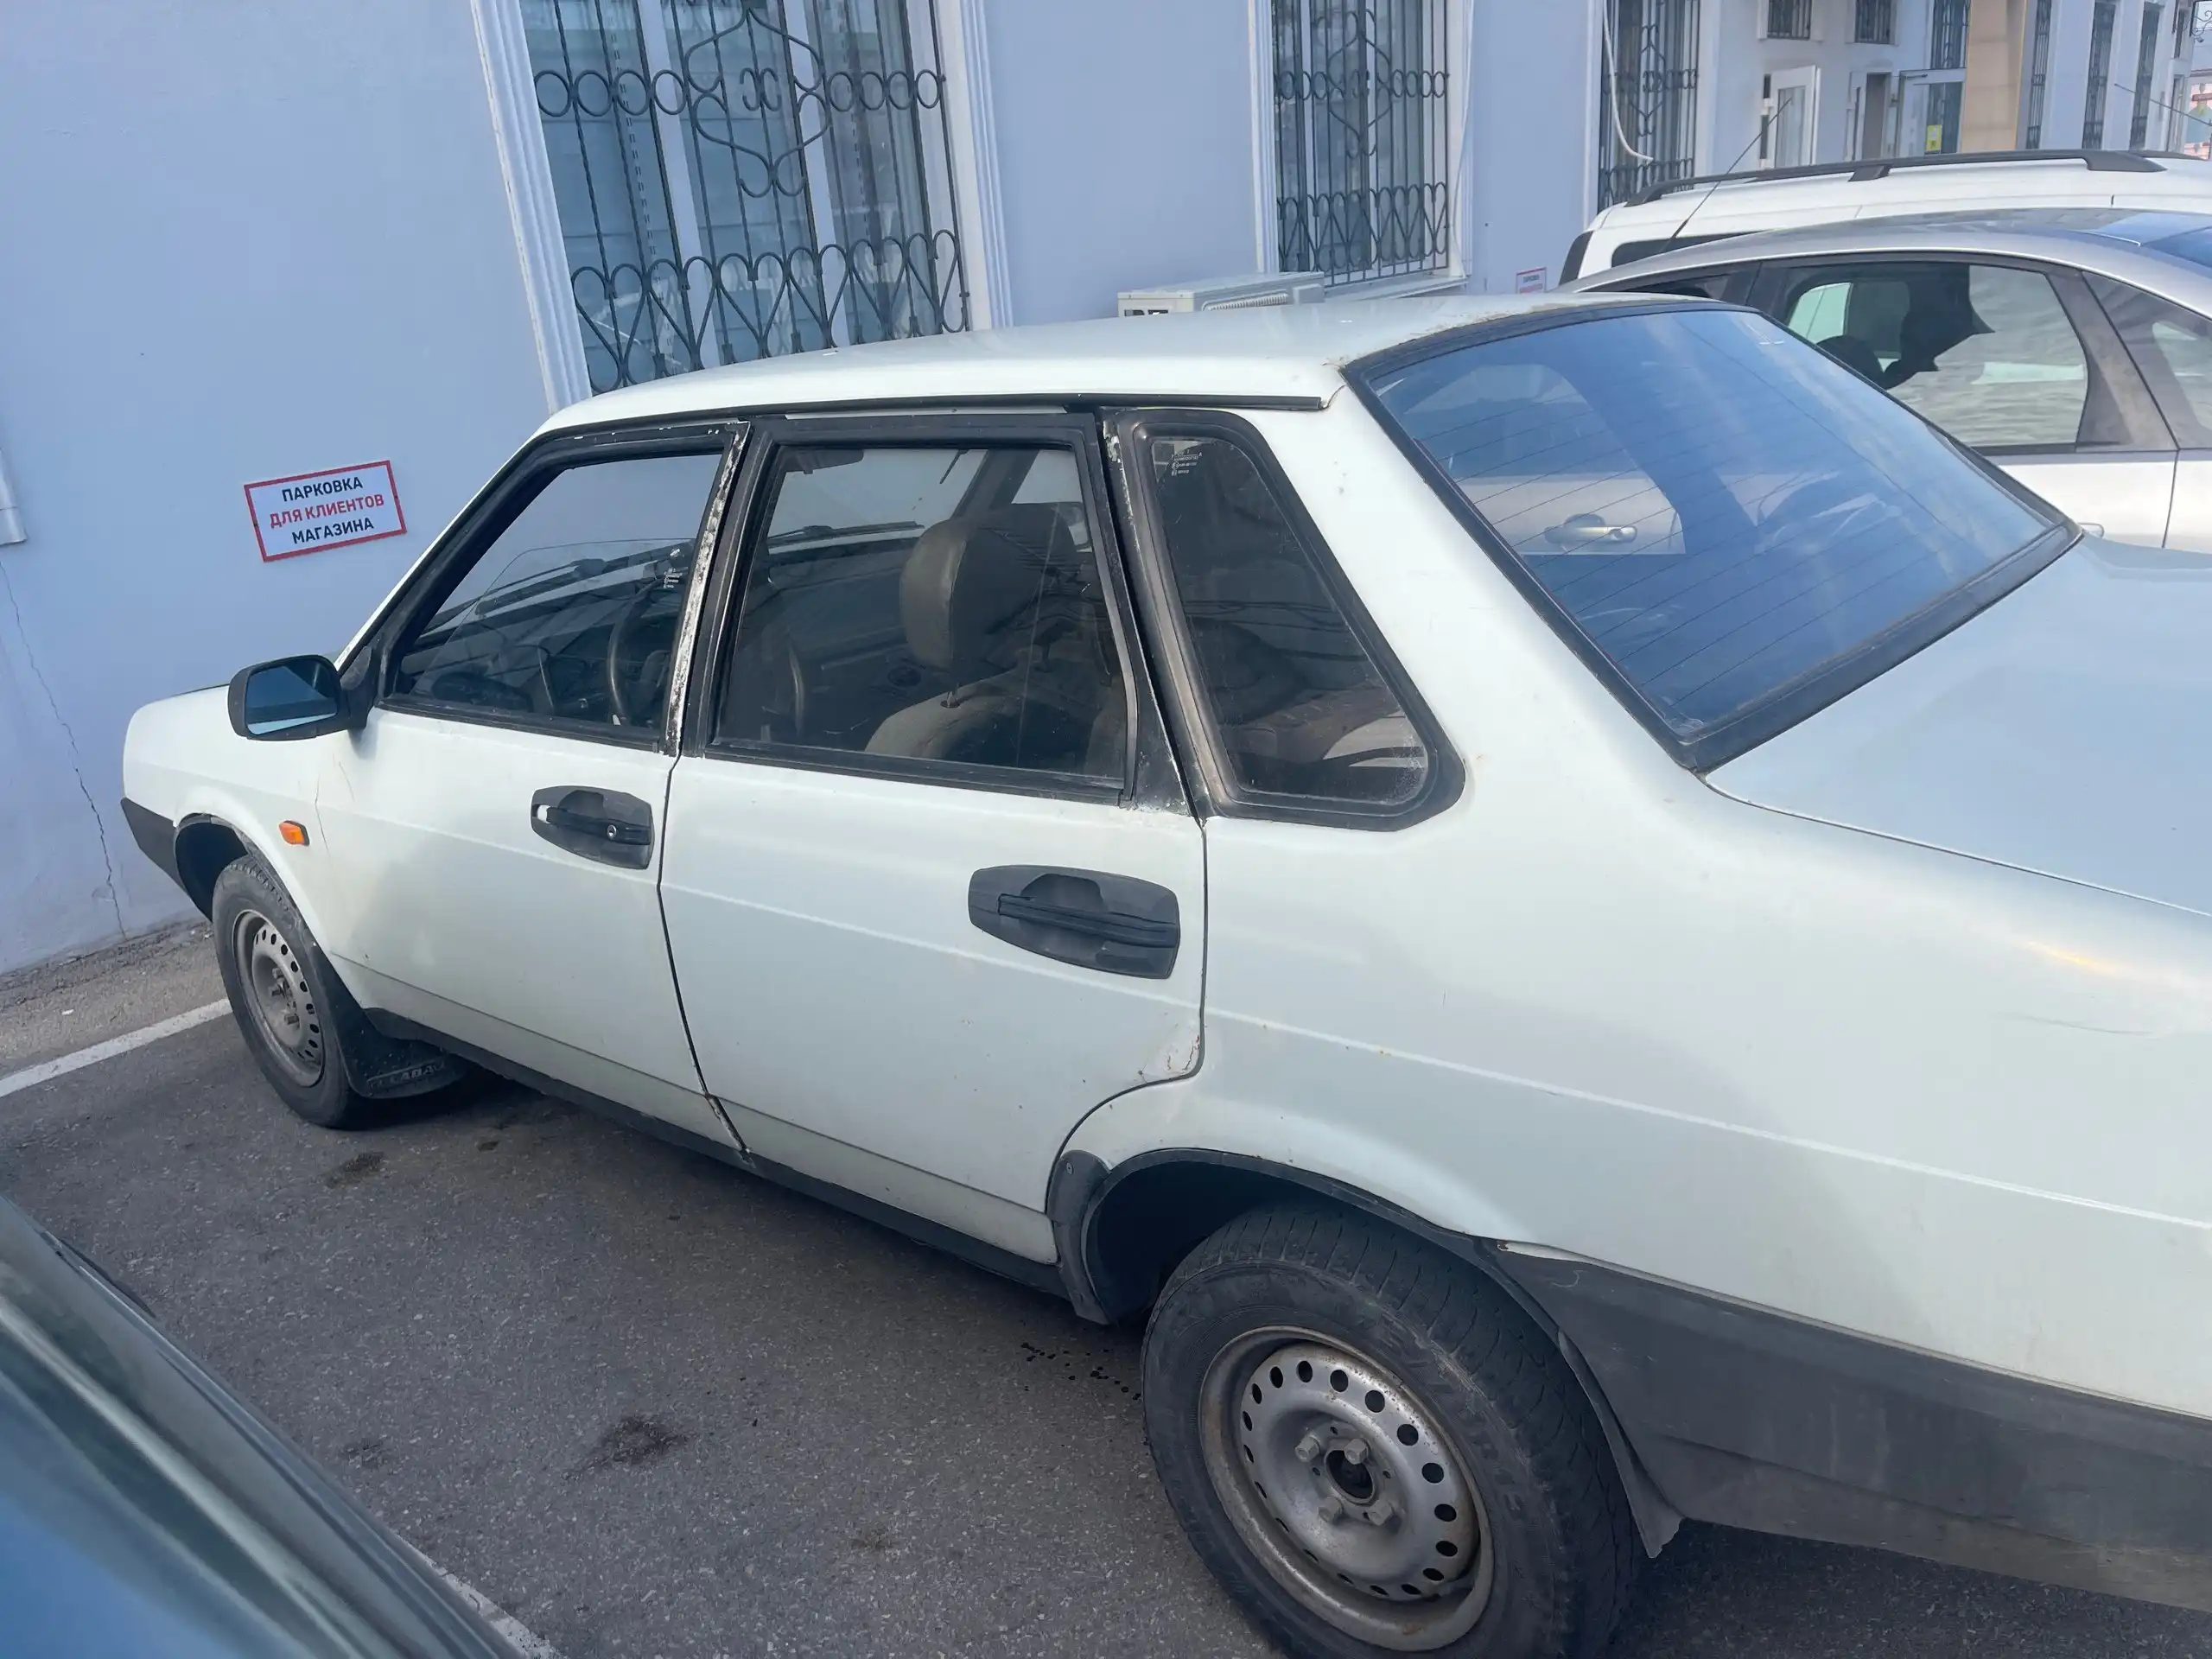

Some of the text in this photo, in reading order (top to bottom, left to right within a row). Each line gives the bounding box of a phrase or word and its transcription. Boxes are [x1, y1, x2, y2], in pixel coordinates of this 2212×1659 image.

[282, 477, 363, 502] ПАРКОВКА
[270, 494, 385, 529] ДЛЯ КЛИЕНТОВ
[292, 518, 374, 544] МАГАЗИНА
